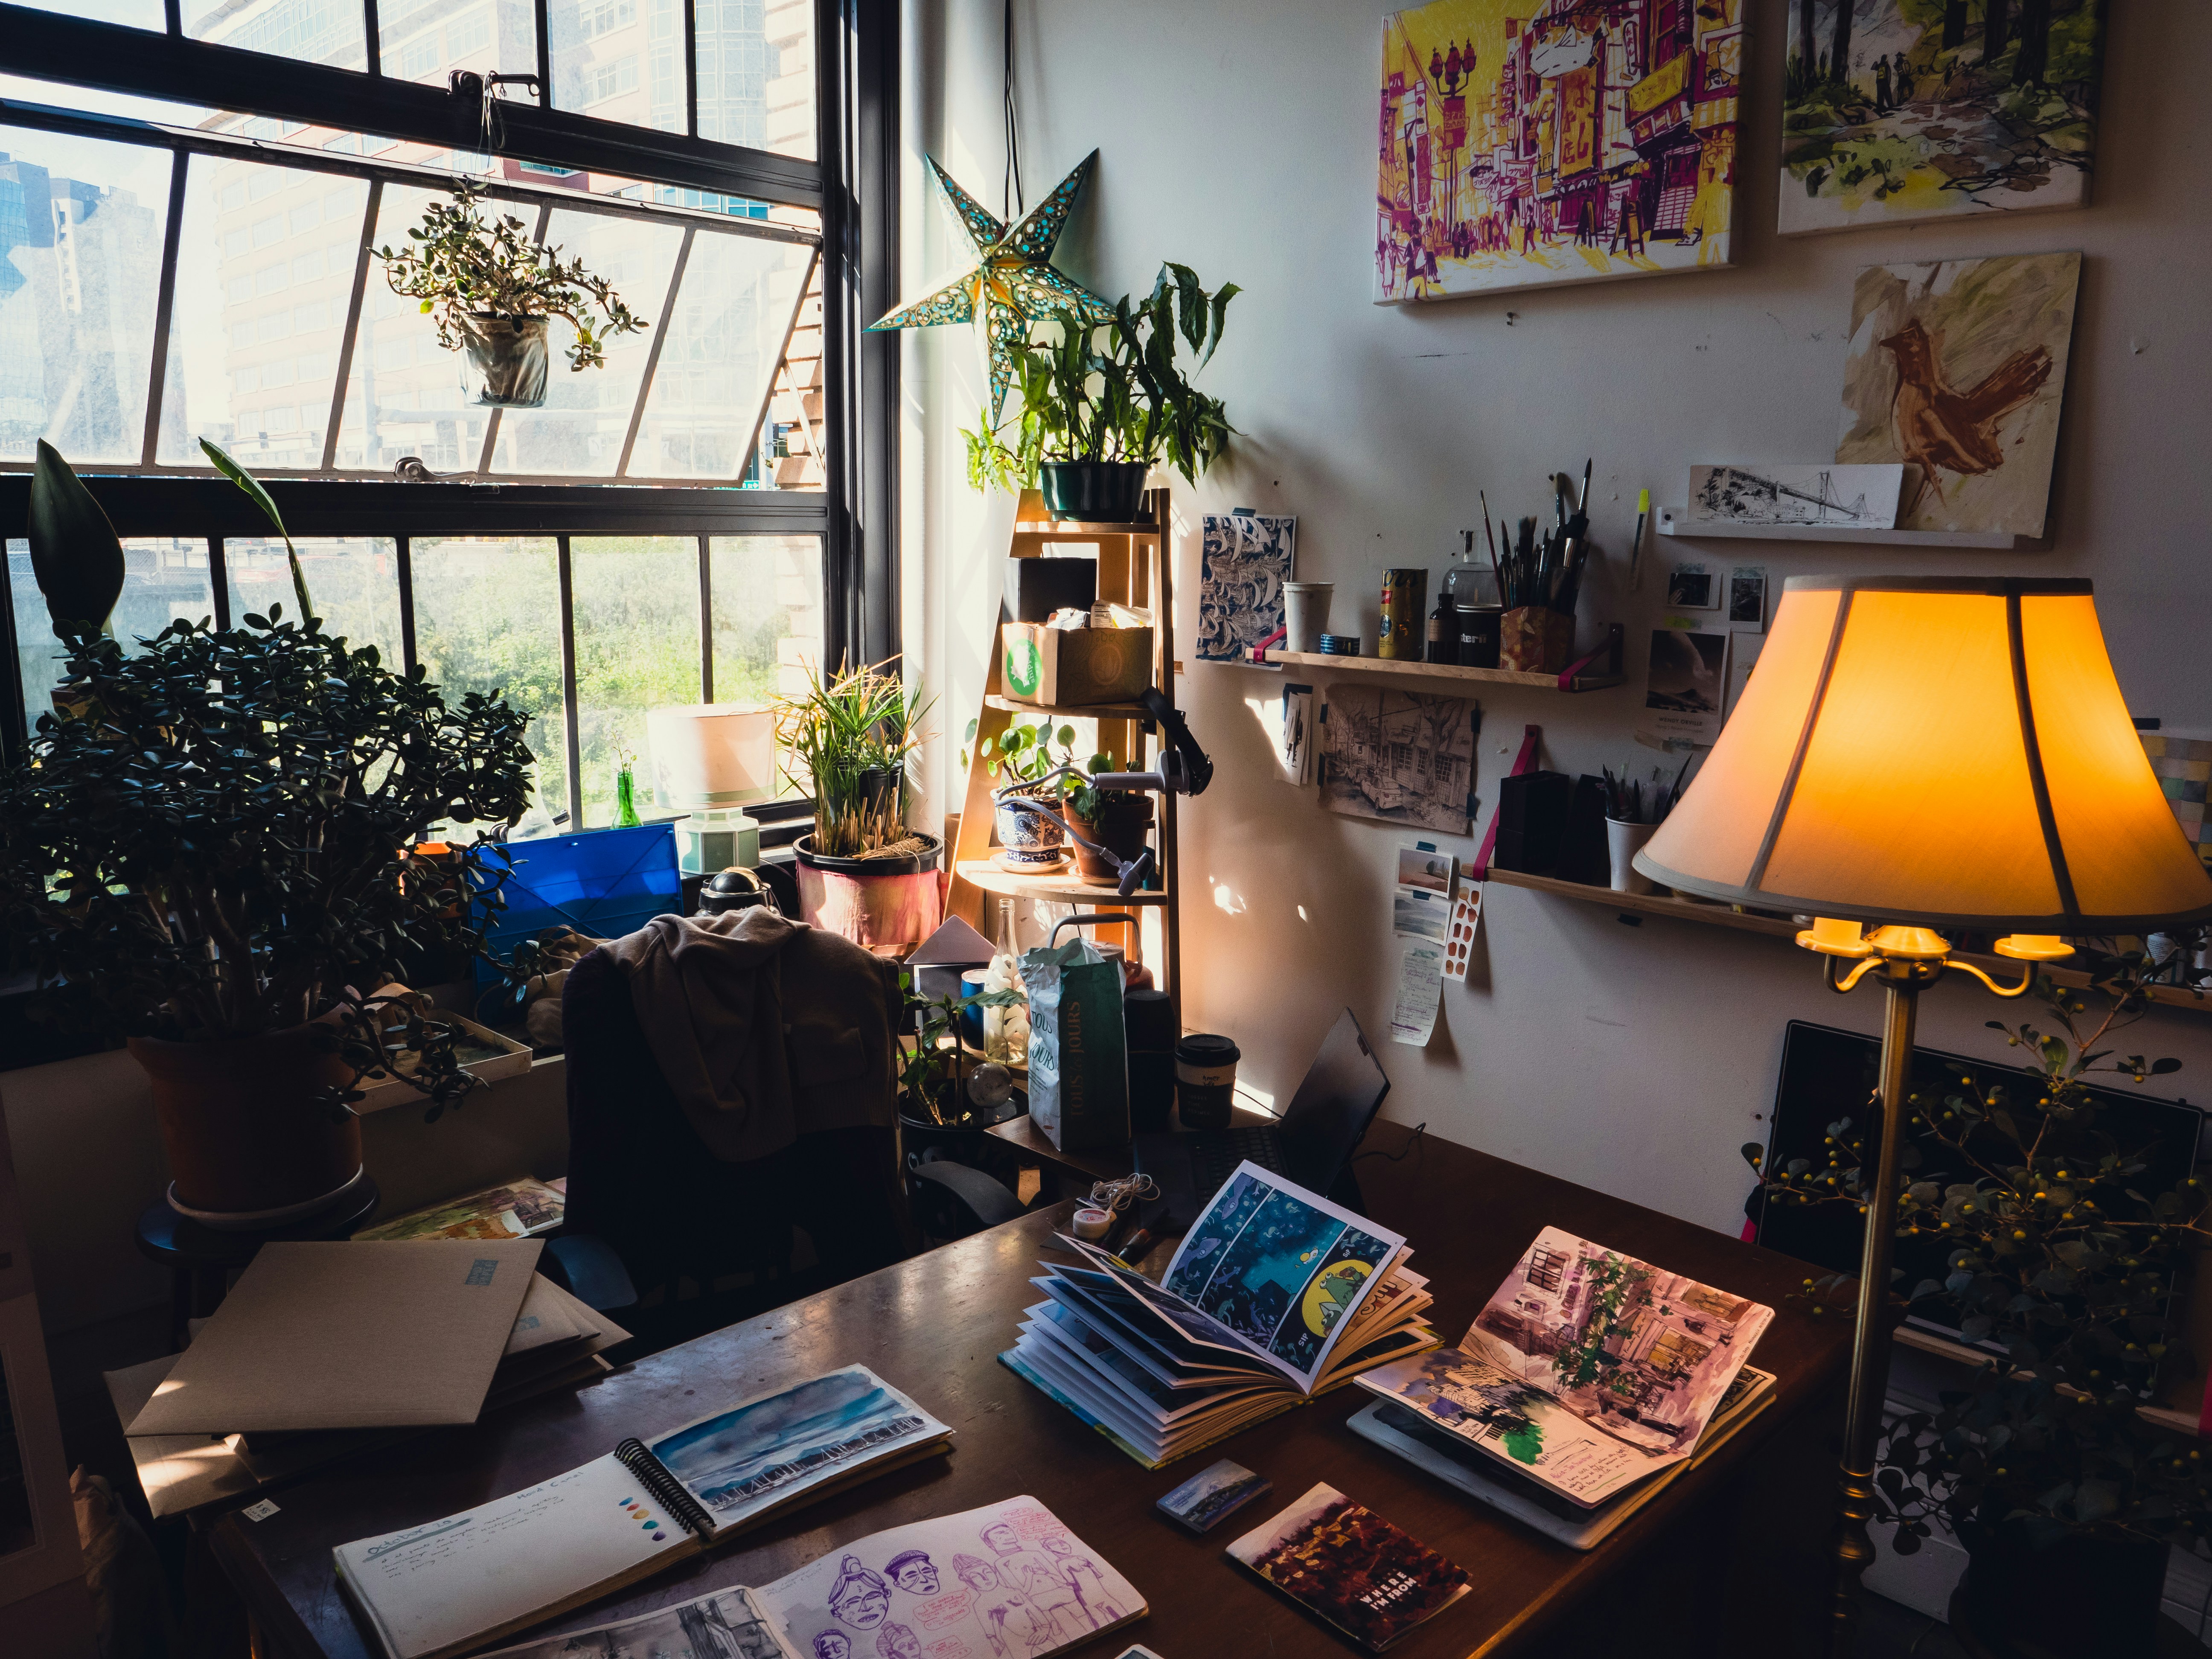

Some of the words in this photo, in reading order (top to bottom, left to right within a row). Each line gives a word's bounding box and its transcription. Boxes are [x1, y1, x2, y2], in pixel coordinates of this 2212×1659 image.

[1031, 1010, 1053, 1034] TOUS
[1067, 1001, 1081, 1054] JOURS
[1028, 1041, 1055, 1071] JOURS
[1071, 1054, 1084, 1072] les
[1068, 1075, 1084, 1120] TOUS
[1342, 1249, 1350, 1257] SIP
[1298, 1333, 1309, 1347] SIP
[550, 1471, 584, 1487] Canal
[367, 1526, 426, 1554] October
[1360, 1571, 1407, 1604] WHERE
[1370, 1596, 1389, 1610] I'M
[1387, 1578, 1417, 1600] FROM
